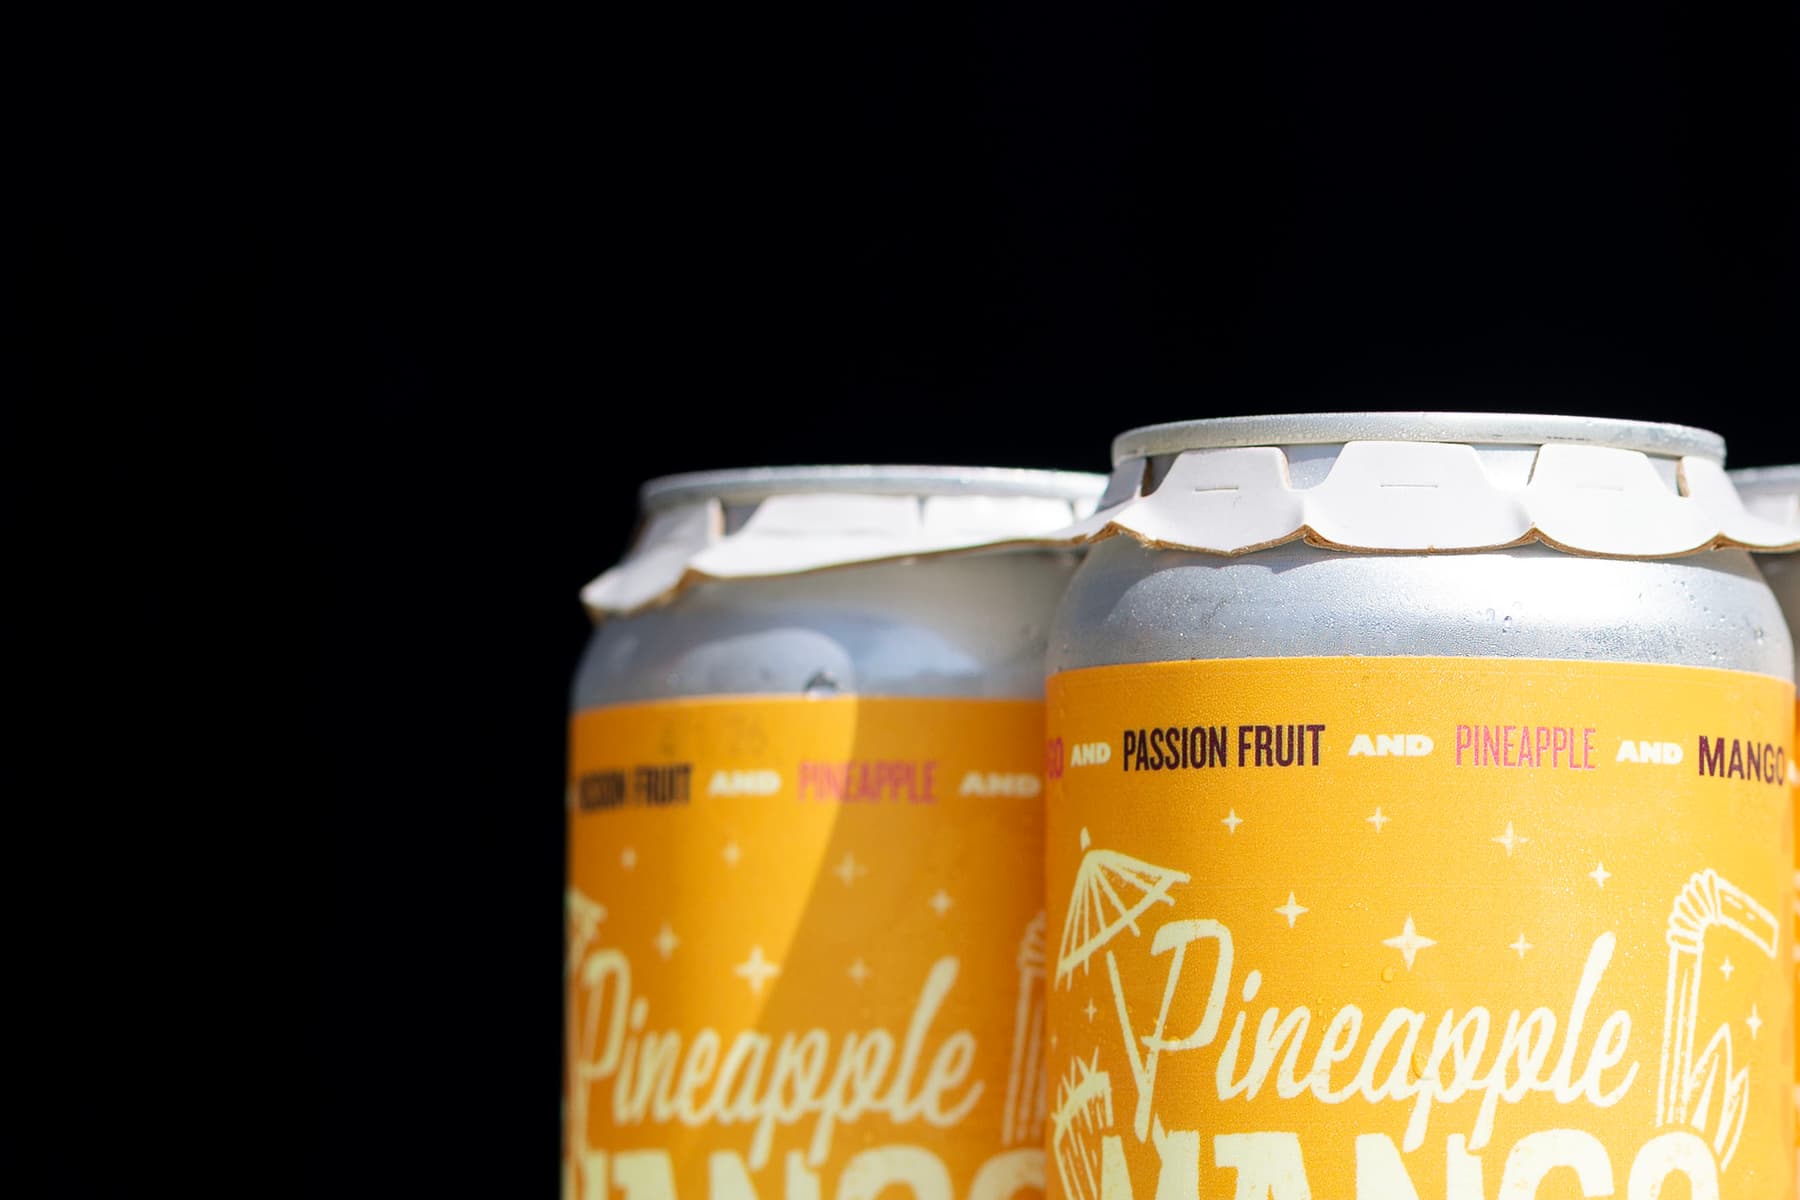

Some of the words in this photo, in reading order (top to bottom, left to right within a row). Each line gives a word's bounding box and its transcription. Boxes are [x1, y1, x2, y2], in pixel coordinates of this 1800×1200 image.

[708, 770, 781, 797] AND
[798, 761, 938, 804] PINEAPPLE
[960, 772, 1041, 797] AND
[1071, 742, 1111, 767] AND
[1123, 726, 1227, 771] PASSION
[1238, 724, 1325, 767] FRUIT
[1348, 734, 1434, 757] AND
[1455, 725, 1596, 769] PINEAPPLE
[1616, 740, 1683, 764] AND
[1698, 735, 1785, 786] MANGO
[576, 949, 984, 1170] Pineapple
[1137, 918, 1640, 1152] Pineapple
